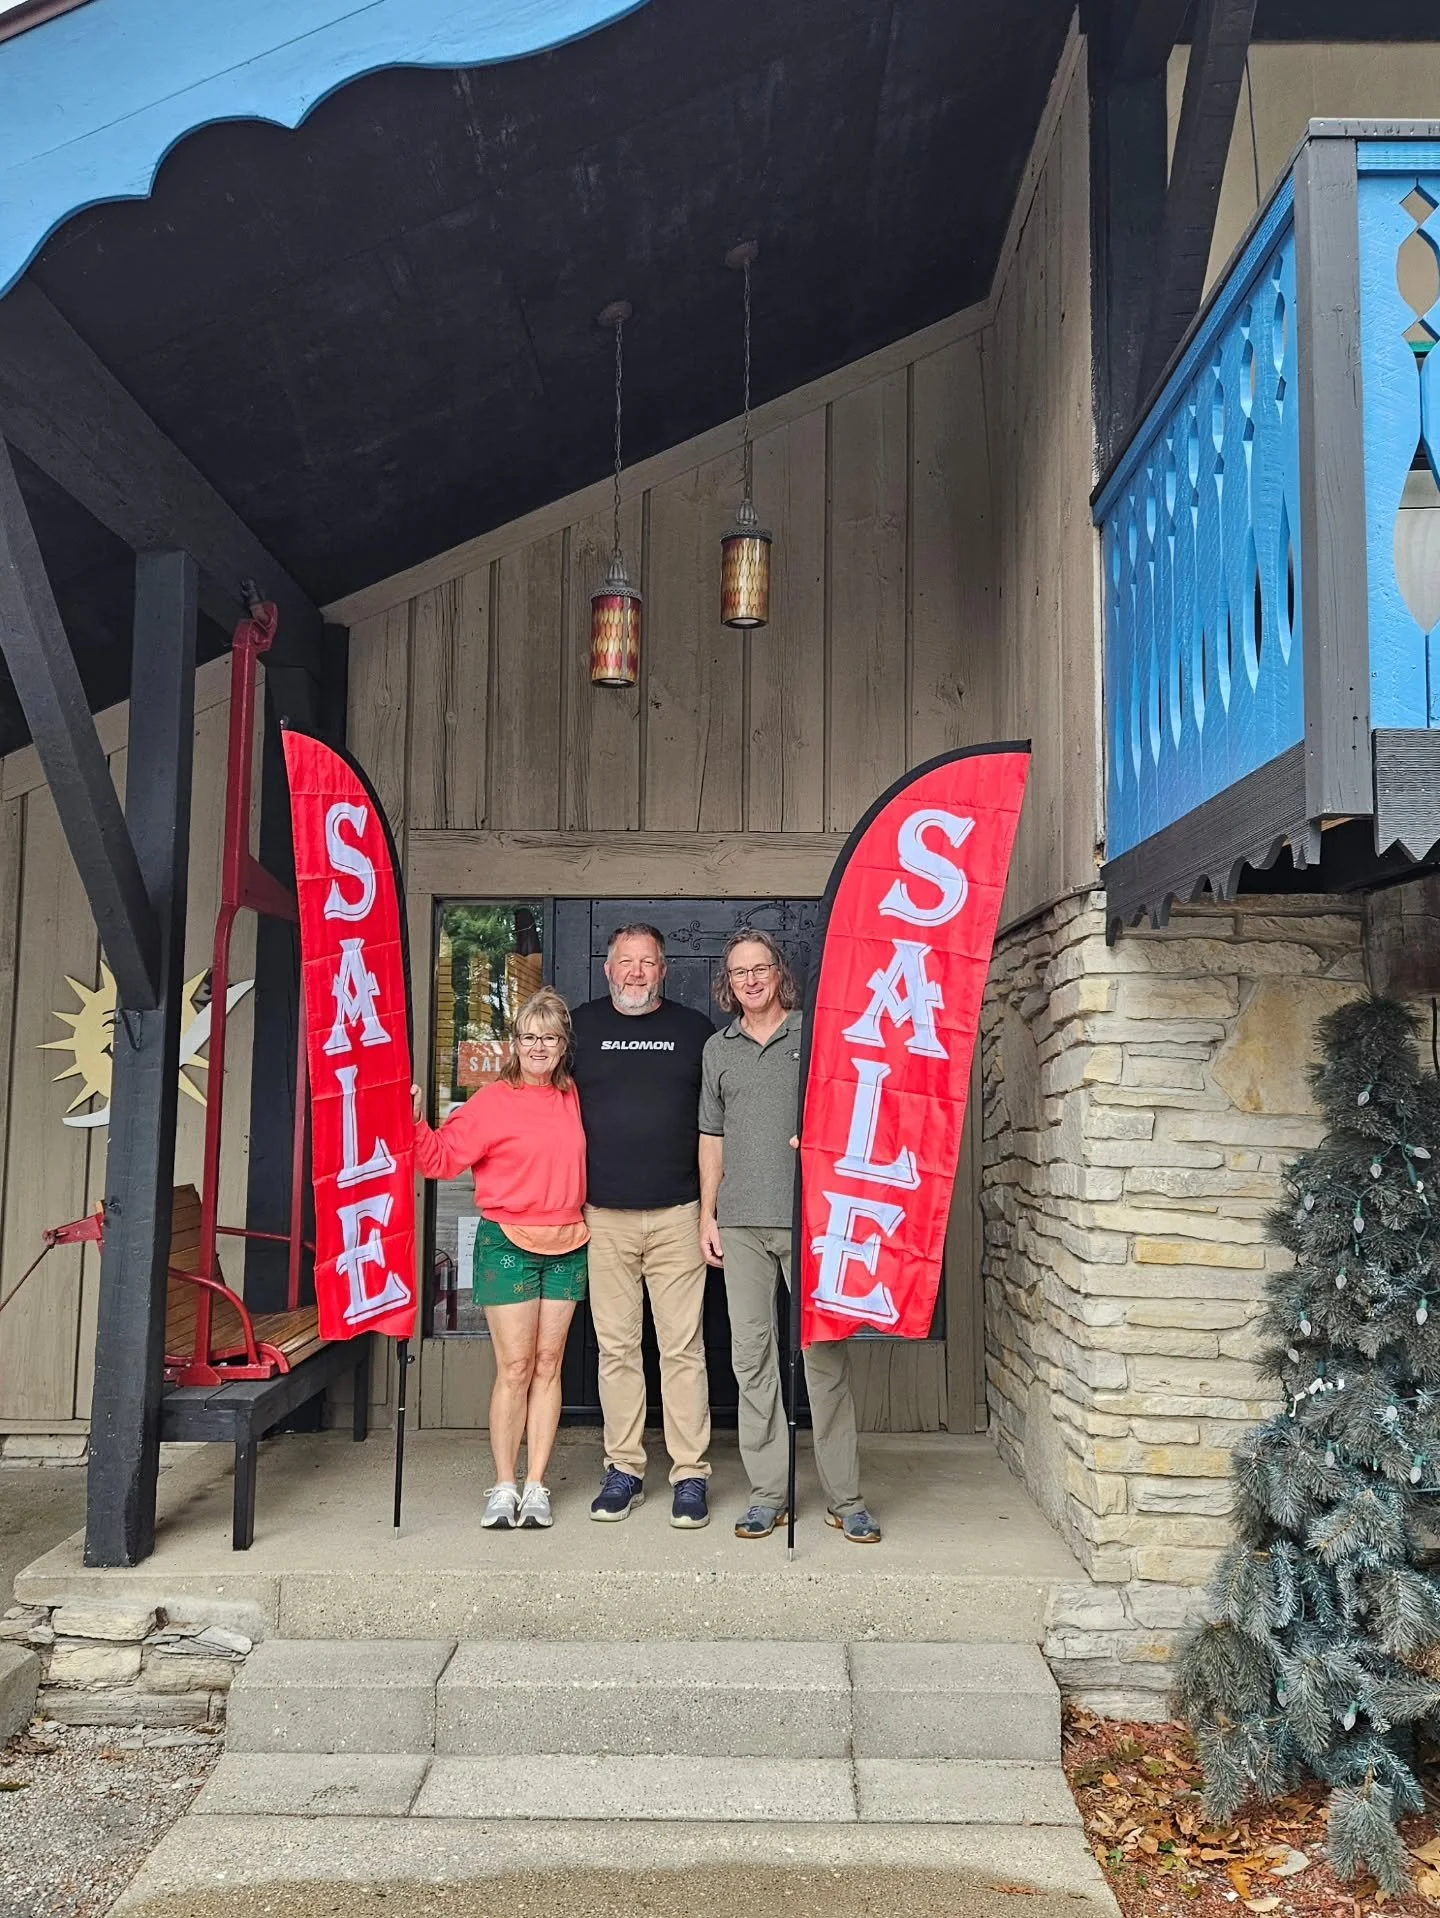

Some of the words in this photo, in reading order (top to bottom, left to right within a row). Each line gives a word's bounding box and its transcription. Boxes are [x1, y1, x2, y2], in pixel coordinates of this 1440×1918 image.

[322, 801, 411, 1325] SALE
[469, 1056, 503, 1072] SAL
[600, 1040, 675, 1051] SALOMON
[810, 808, 977, 1325] SALE
